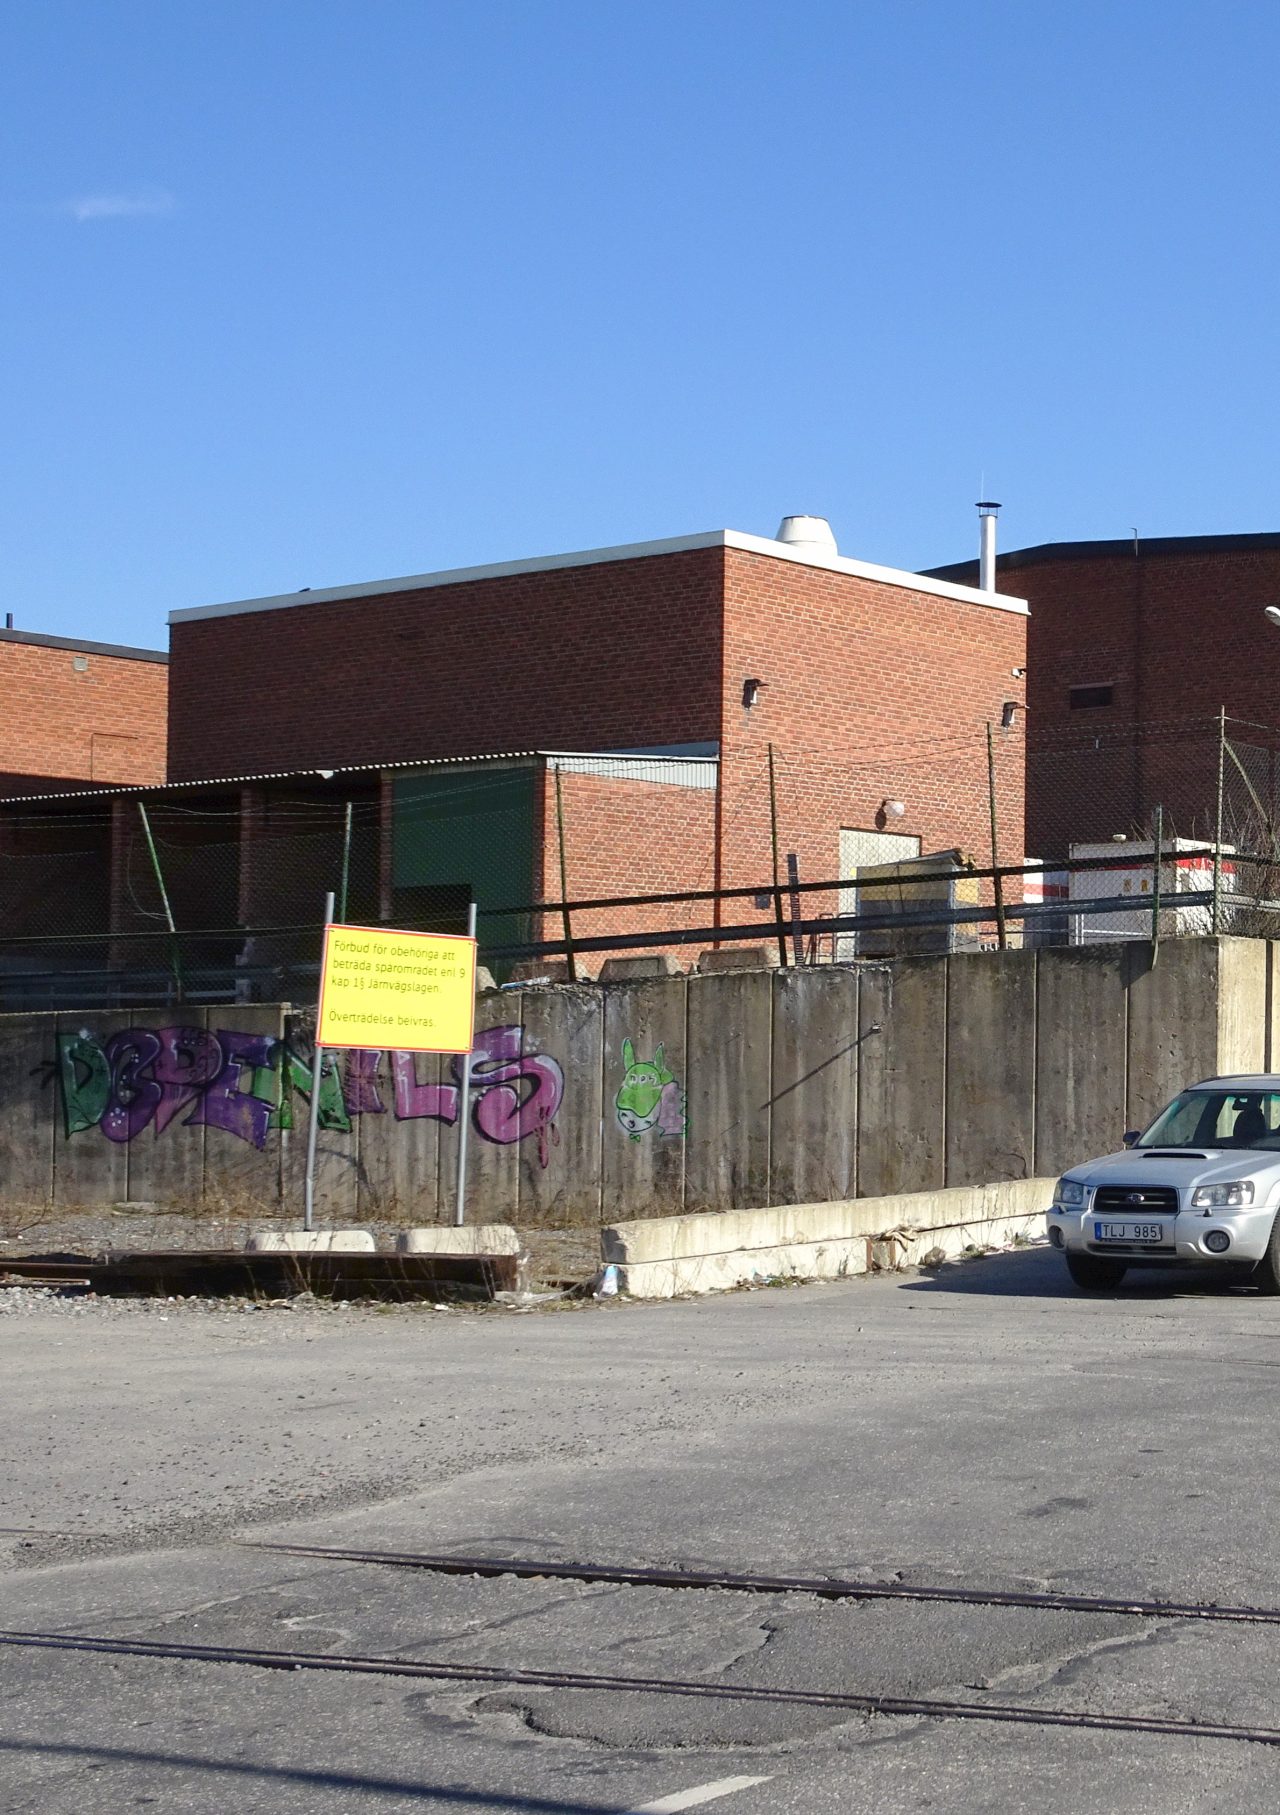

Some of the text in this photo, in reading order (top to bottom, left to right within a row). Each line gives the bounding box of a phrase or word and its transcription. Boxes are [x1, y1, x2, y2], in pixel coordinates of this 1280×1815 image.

[334, 940, 370, 954] Förbud
[373, 943, 388, 955] för
[442, 951, 455, 961] att
[440, 966, 456, 978] enl
[459, 968, 466, 979] 9
[331, 976, 349, 988] kap
[397, 1015, 436, 1027] beivras.
[1103, 1224, 1157, 1238] TLJ 985
